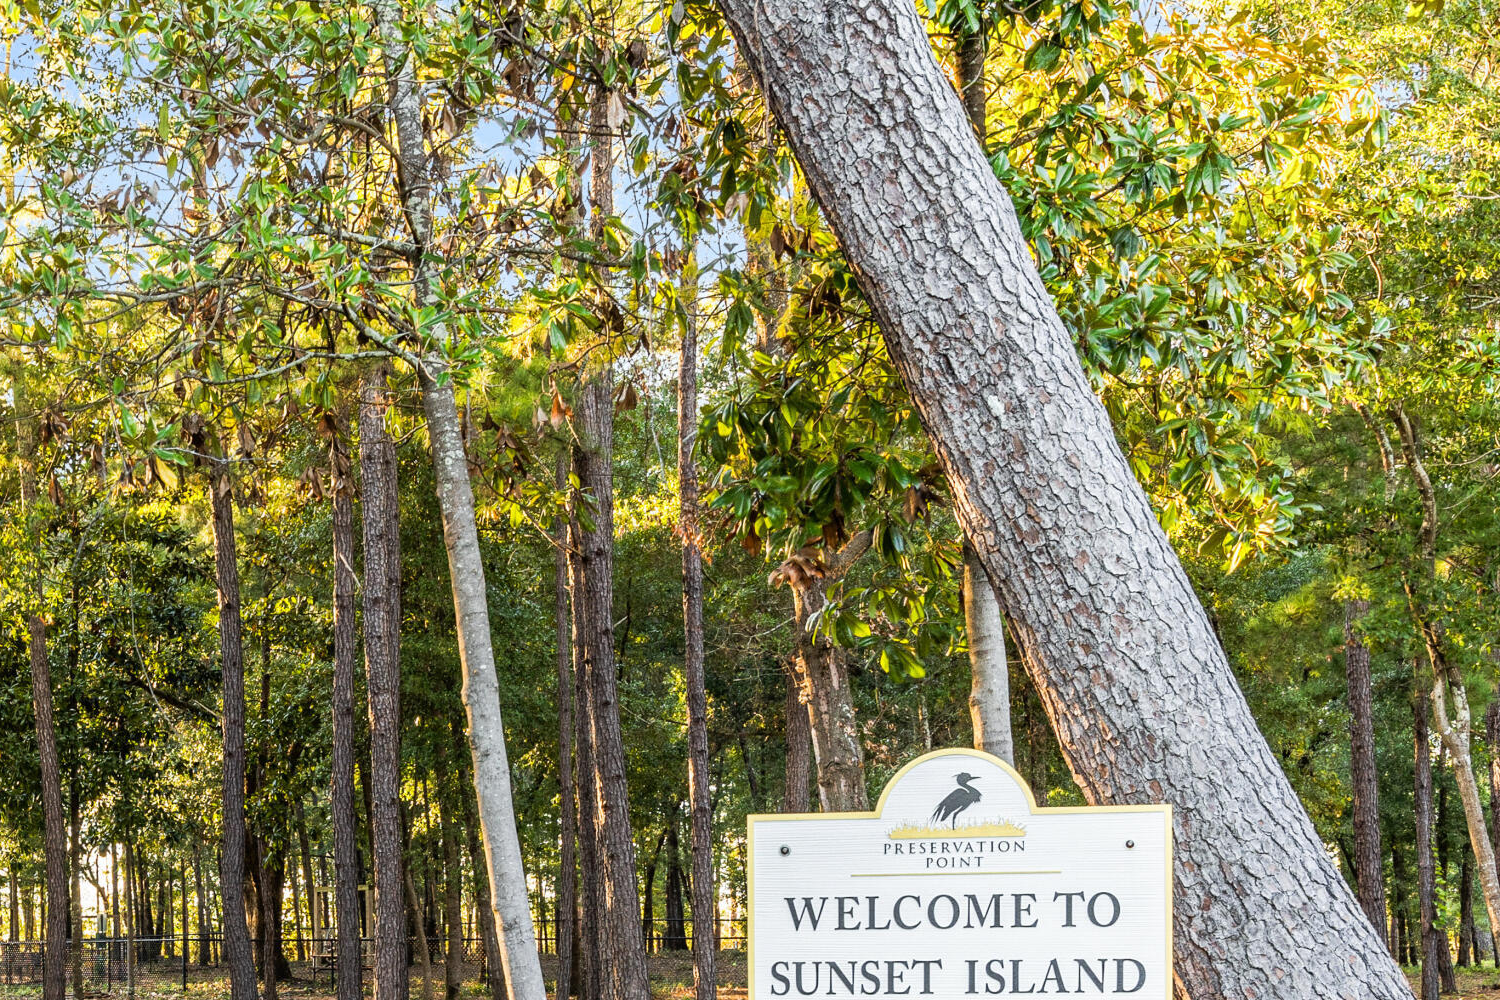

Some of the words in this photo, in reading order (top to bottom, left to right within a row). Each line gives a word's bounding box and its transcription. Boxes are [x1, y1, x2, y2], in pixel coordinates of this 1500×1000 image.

[883, 840, 1026, 855] PRESERVATION
[925, 856, 985, 869] POINT
[784, 893, 1039, 931] WELCOME
[1053, 891, 1121, 928] TO
[770, 959, 942, 996] SUNSET
[964, 958, 1147, 995] ISLAND
